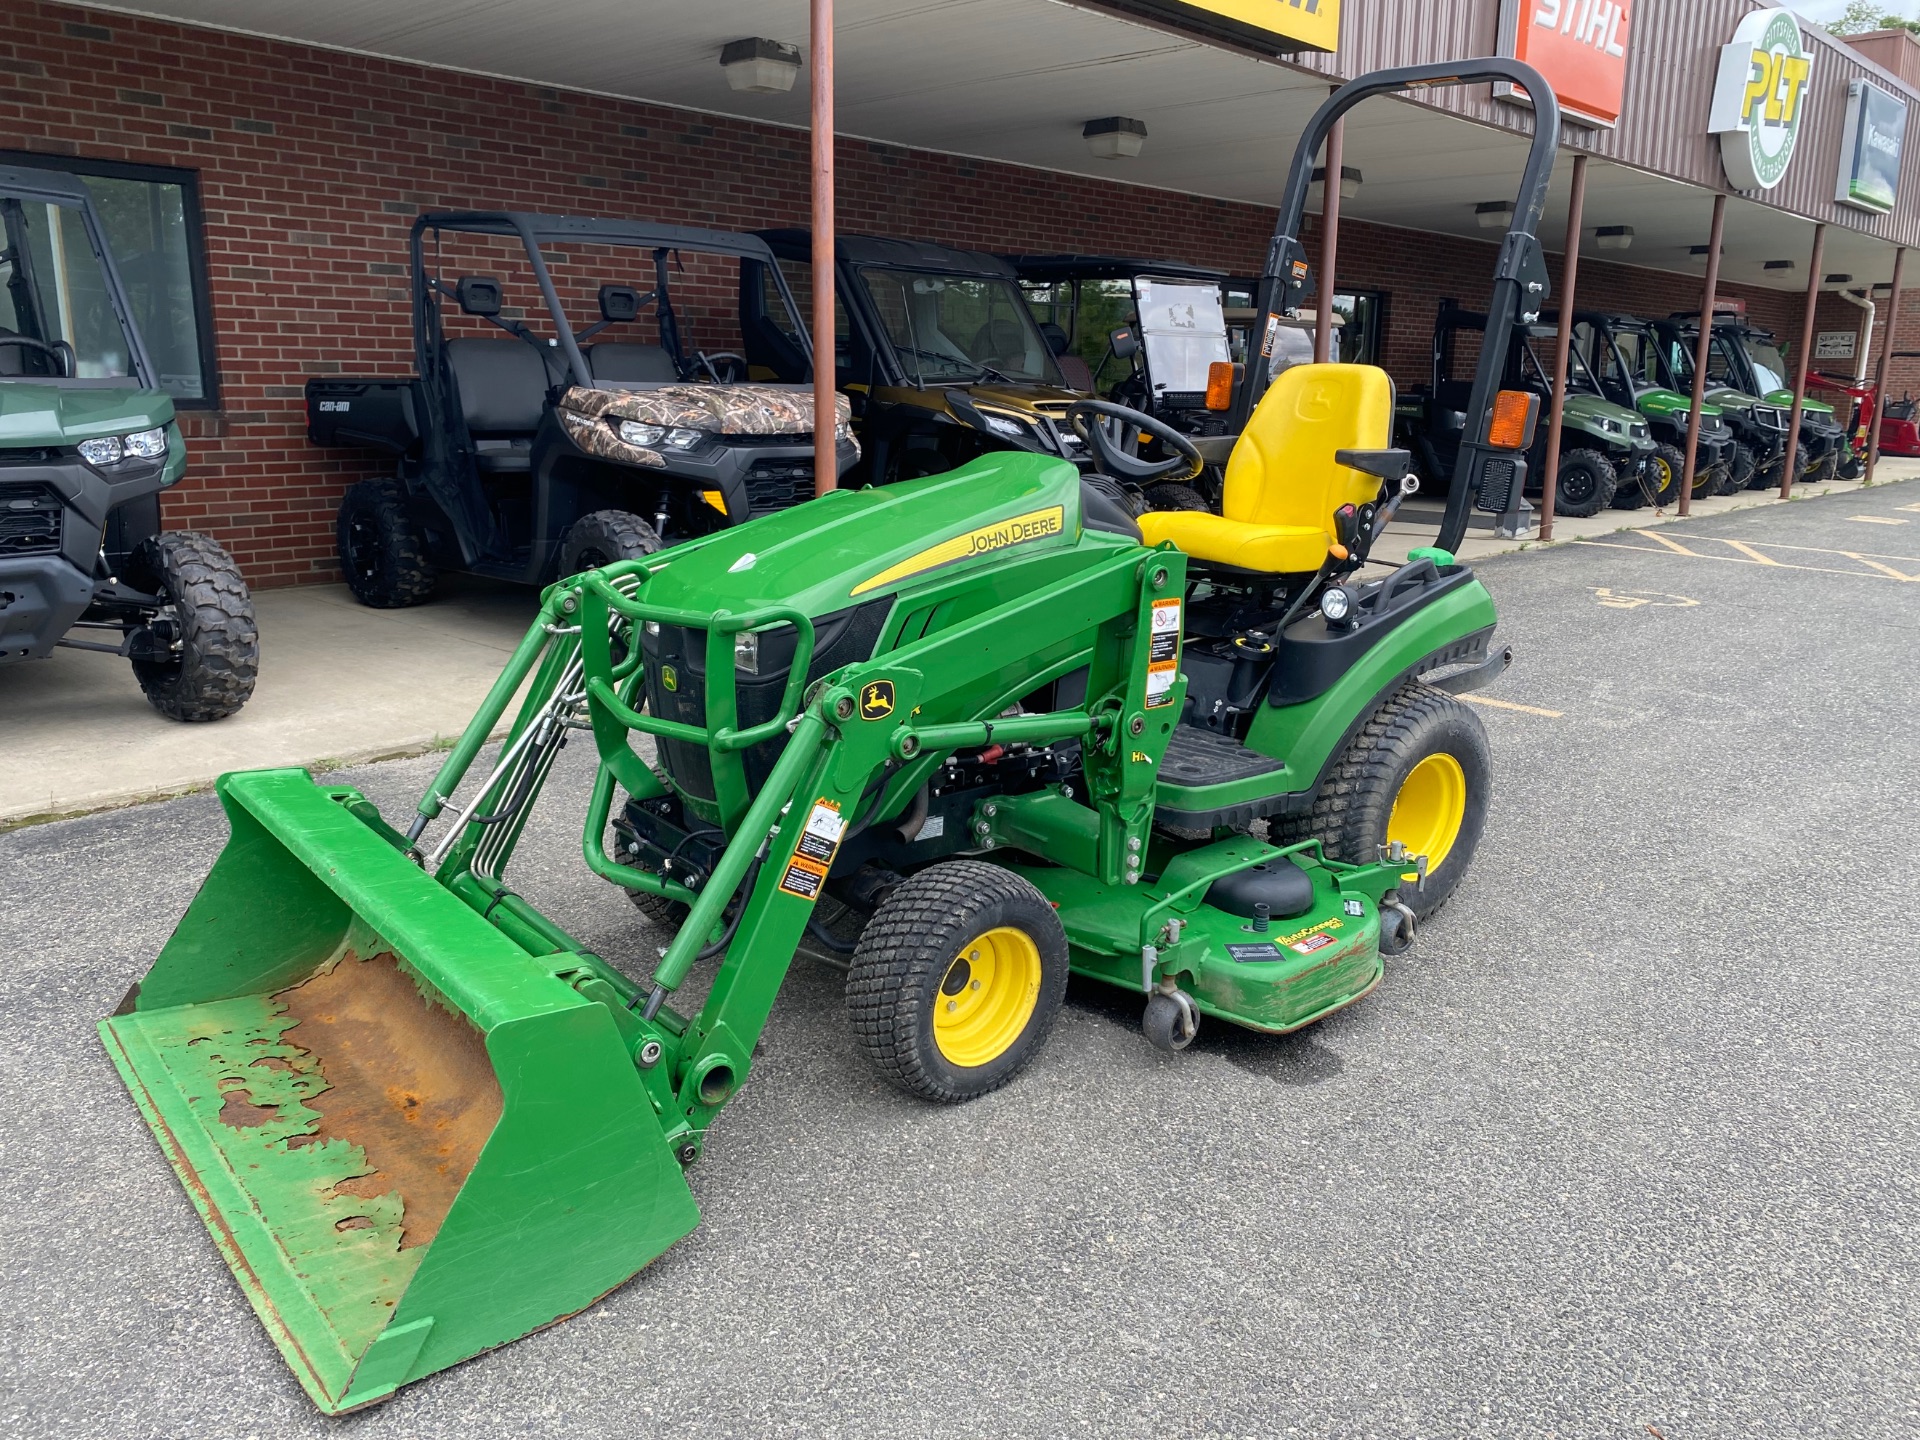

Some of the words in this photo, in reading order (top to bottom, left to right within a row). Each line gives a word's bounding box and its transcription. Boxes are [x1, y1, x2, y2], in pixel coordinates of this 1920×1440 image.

[1533, 0, 1625, 58] STIHL
[1766, 21, 1798, 55] PITTSFIELD
[1741, 48, 1811, 124] PLT
[1766, 132, 1793, 179] TRACTOR
[1819, 335, 1855, 344] SERVICE
[1817, 347, 1852, 356] RENTALS
[967, 529, 1010, 555] JOHN
[1011, 517, 1058, 541] DEERE
[1158, 599, 1180, 607] WARNING
[1154, 662, 1176, 671] WARNING
[800, 861, 823, 874] WARNING
